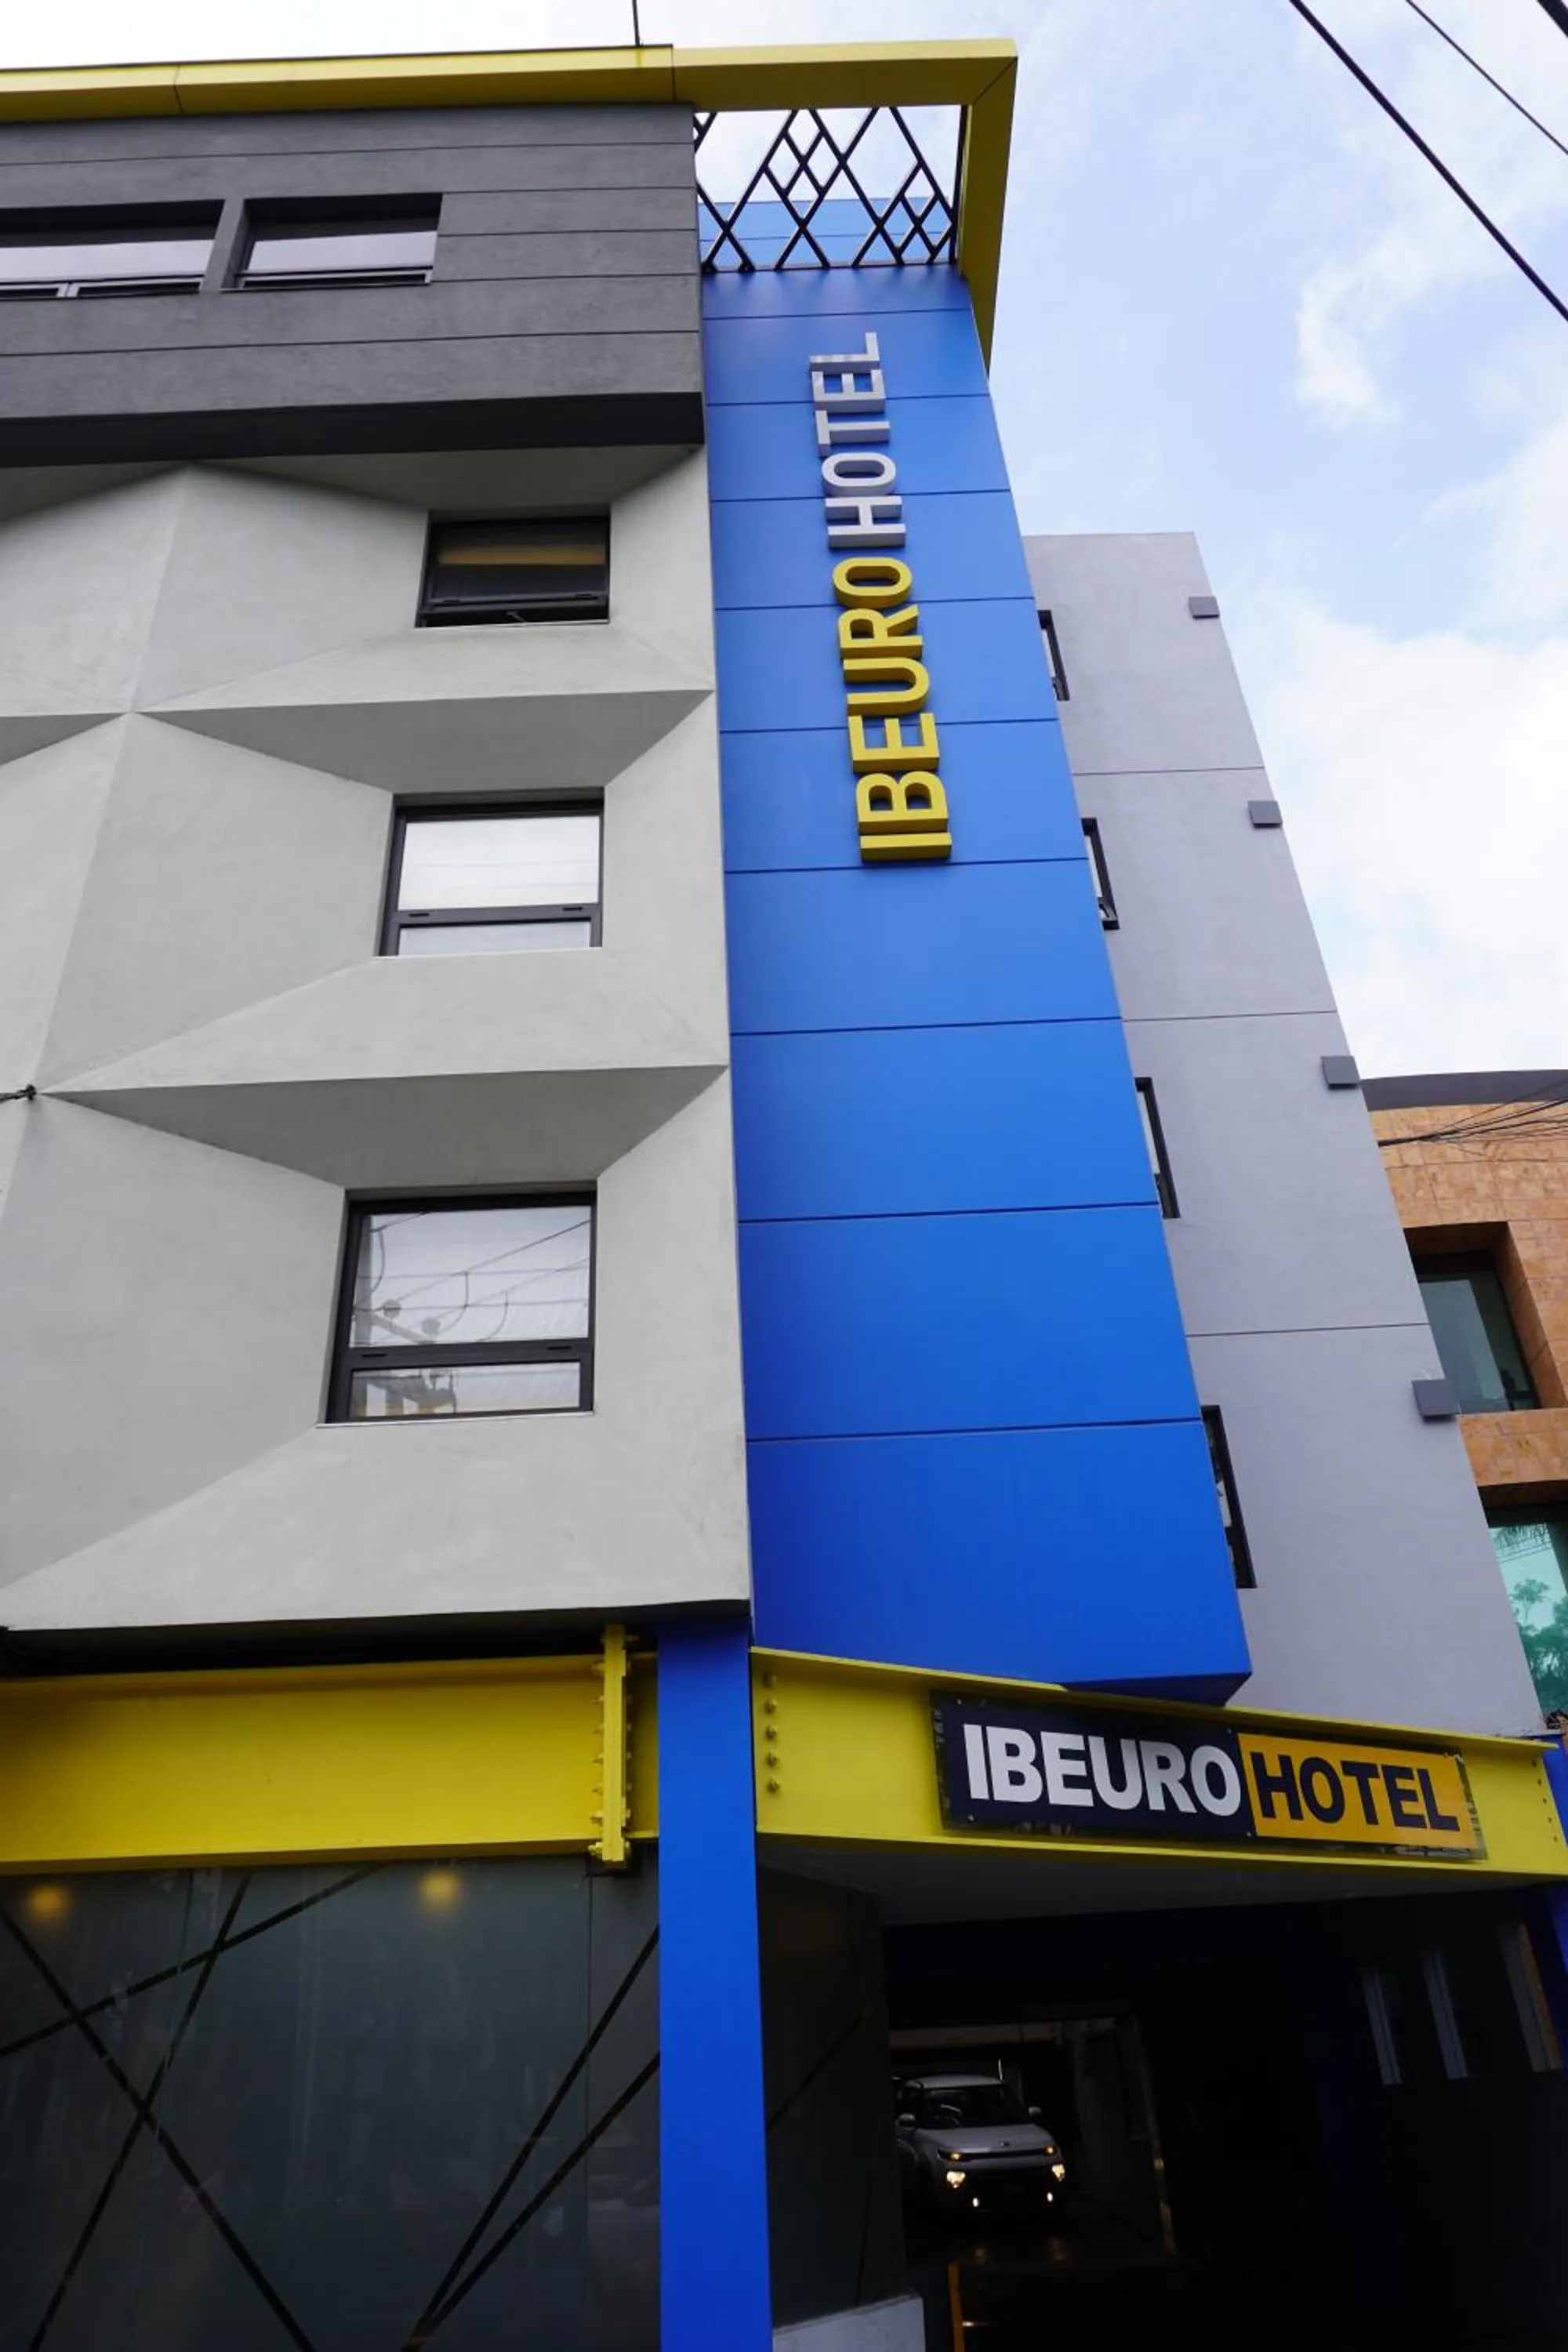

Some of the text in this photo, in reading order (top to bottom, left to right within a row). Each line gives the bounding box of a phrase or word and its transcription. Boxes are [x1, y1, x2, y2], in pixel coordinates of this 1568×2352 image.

[809, 332, 906, 549] HOTEL
[964, 1723, 1460, 1832] IBEURO HOTEL
